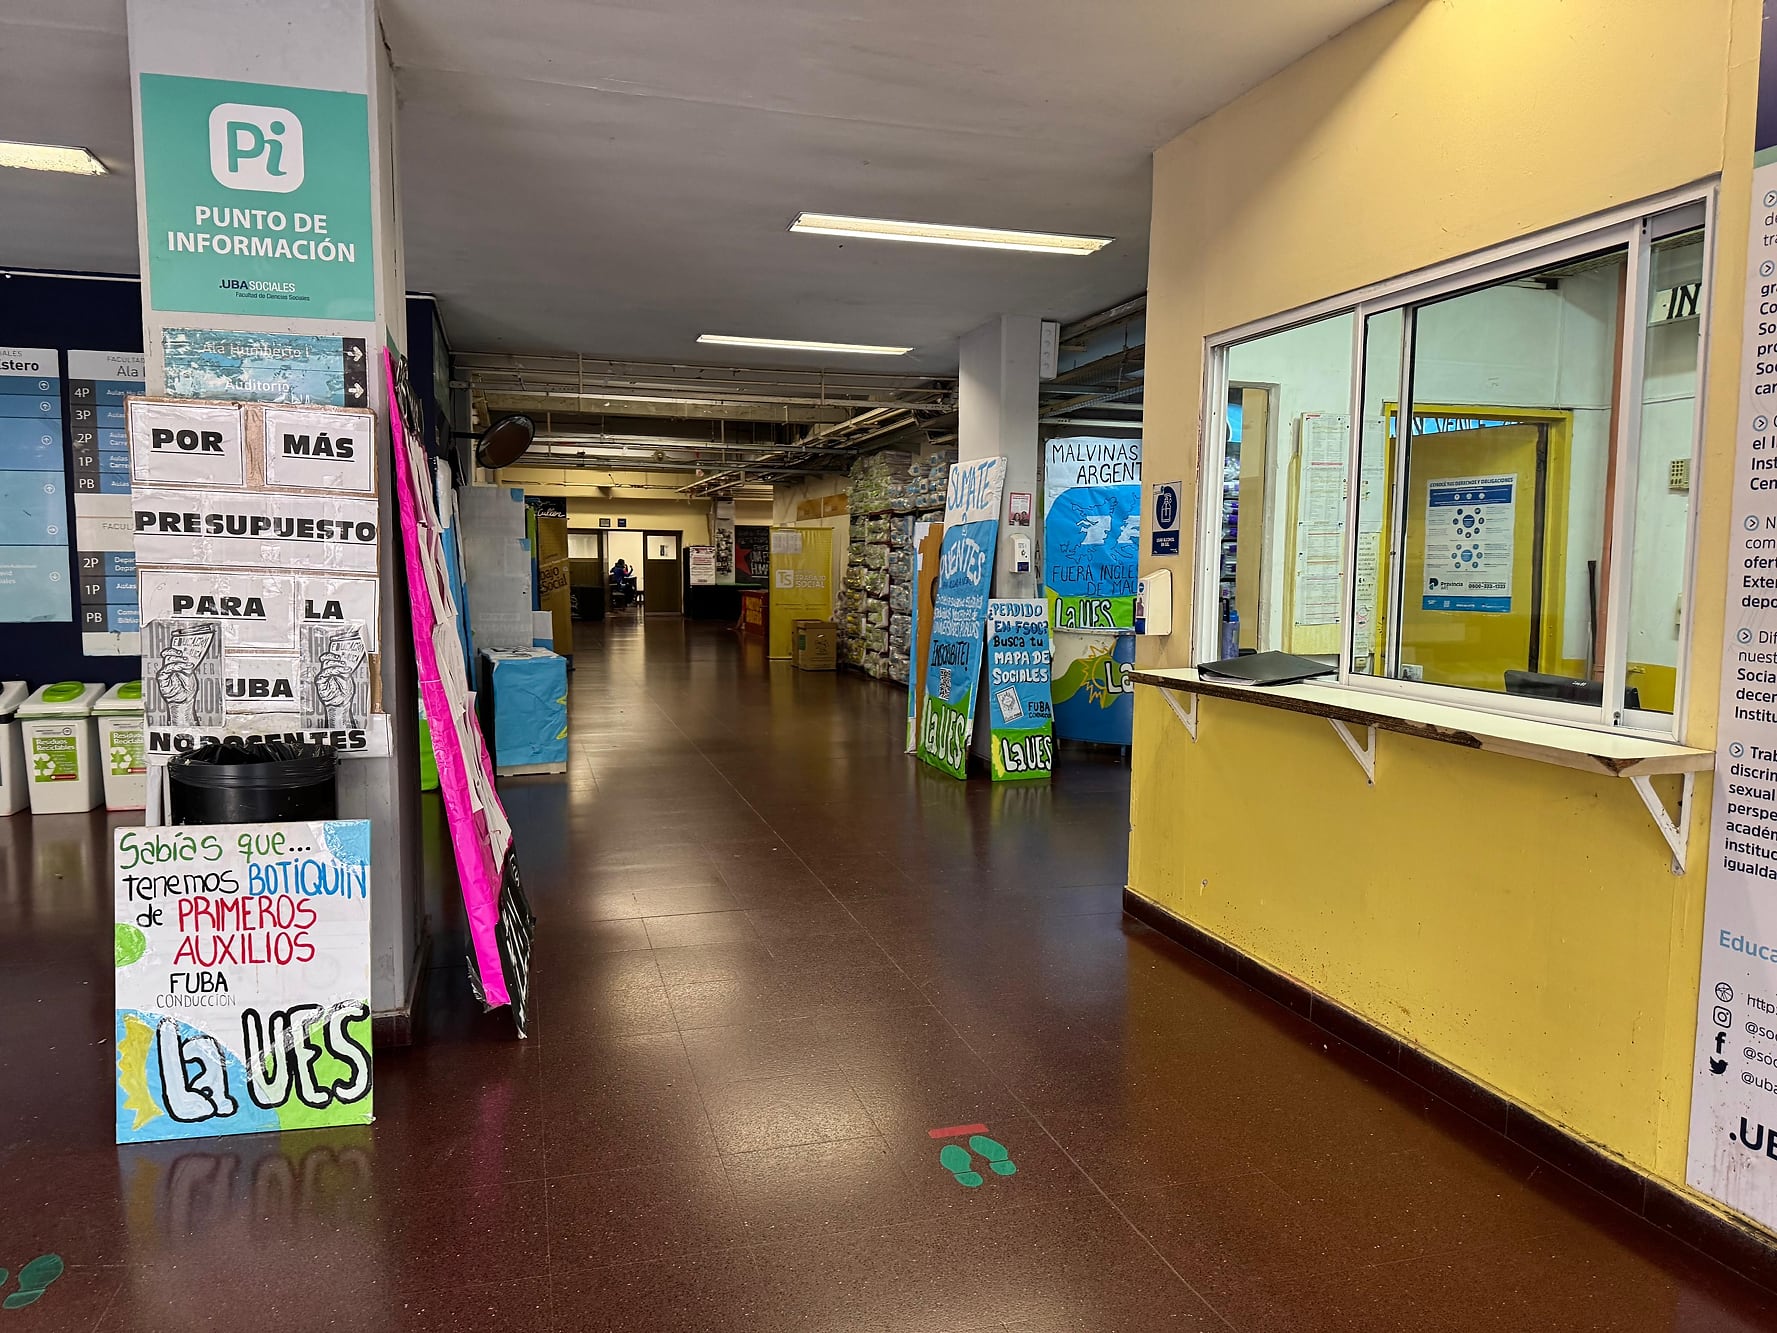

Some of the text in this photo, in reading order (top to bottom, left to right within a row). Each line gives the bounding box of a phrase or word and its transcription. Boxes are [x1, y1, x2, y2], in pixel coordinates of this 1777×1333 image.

[195, 205, 328, 234] PUNTO DE
[167, 231, 355, 263] INFORMACIÓN
[1761, 283, 1777, 298] gr
[0, 359, 39, 371] stero
[116, 365, 139, 377] Ala
[74, 387, 90, 398] 4P
[225, 380, 290, 393] Auditorio
[75, 410, 91, 420] 3P
[77, 433, 93, 444] 2P
[151, 428, 355, 459] POR MÁS
[1752, 436, 1766, 450] el
[79, 456, 93, 467] 1P
[1052, 443, 1139, 465] MALVINAS
[79, 479, 95, 489] PB
[134, 510, 376, 542] PRESUPUESTO
[1745, 539, 1776, 549] com
[83, 558, 99, 568] 2P
[1052, 565, 1139, 583] FUERA INGLE
[85, 584, 101, 595] 1P
[1087, 581, 1103, 596] DE
[1743, 575, 1777, 589] Exte
[172, 595, 345, 620] PARA LA
[86, 612, 103, 623] PB
[1031, 637, 1044, 648] tu
[994, 650, 1051, 666] MAPA DE
[1737, 668, 1776, 683] Socia
[225, 678, 294, 698] UBA
[1028, 701, 1051, 713] FUBA
[1729, 784, 1775, 802] sexual
[120, 832, 223, 870] Sabías
[122, 870, 239, 900] tenemos
[136, 894, 317, 932] de PRIMEROS
[173, 931, 316, 967] AUXILIOS
[169, 971, 229, 994] FUBA
